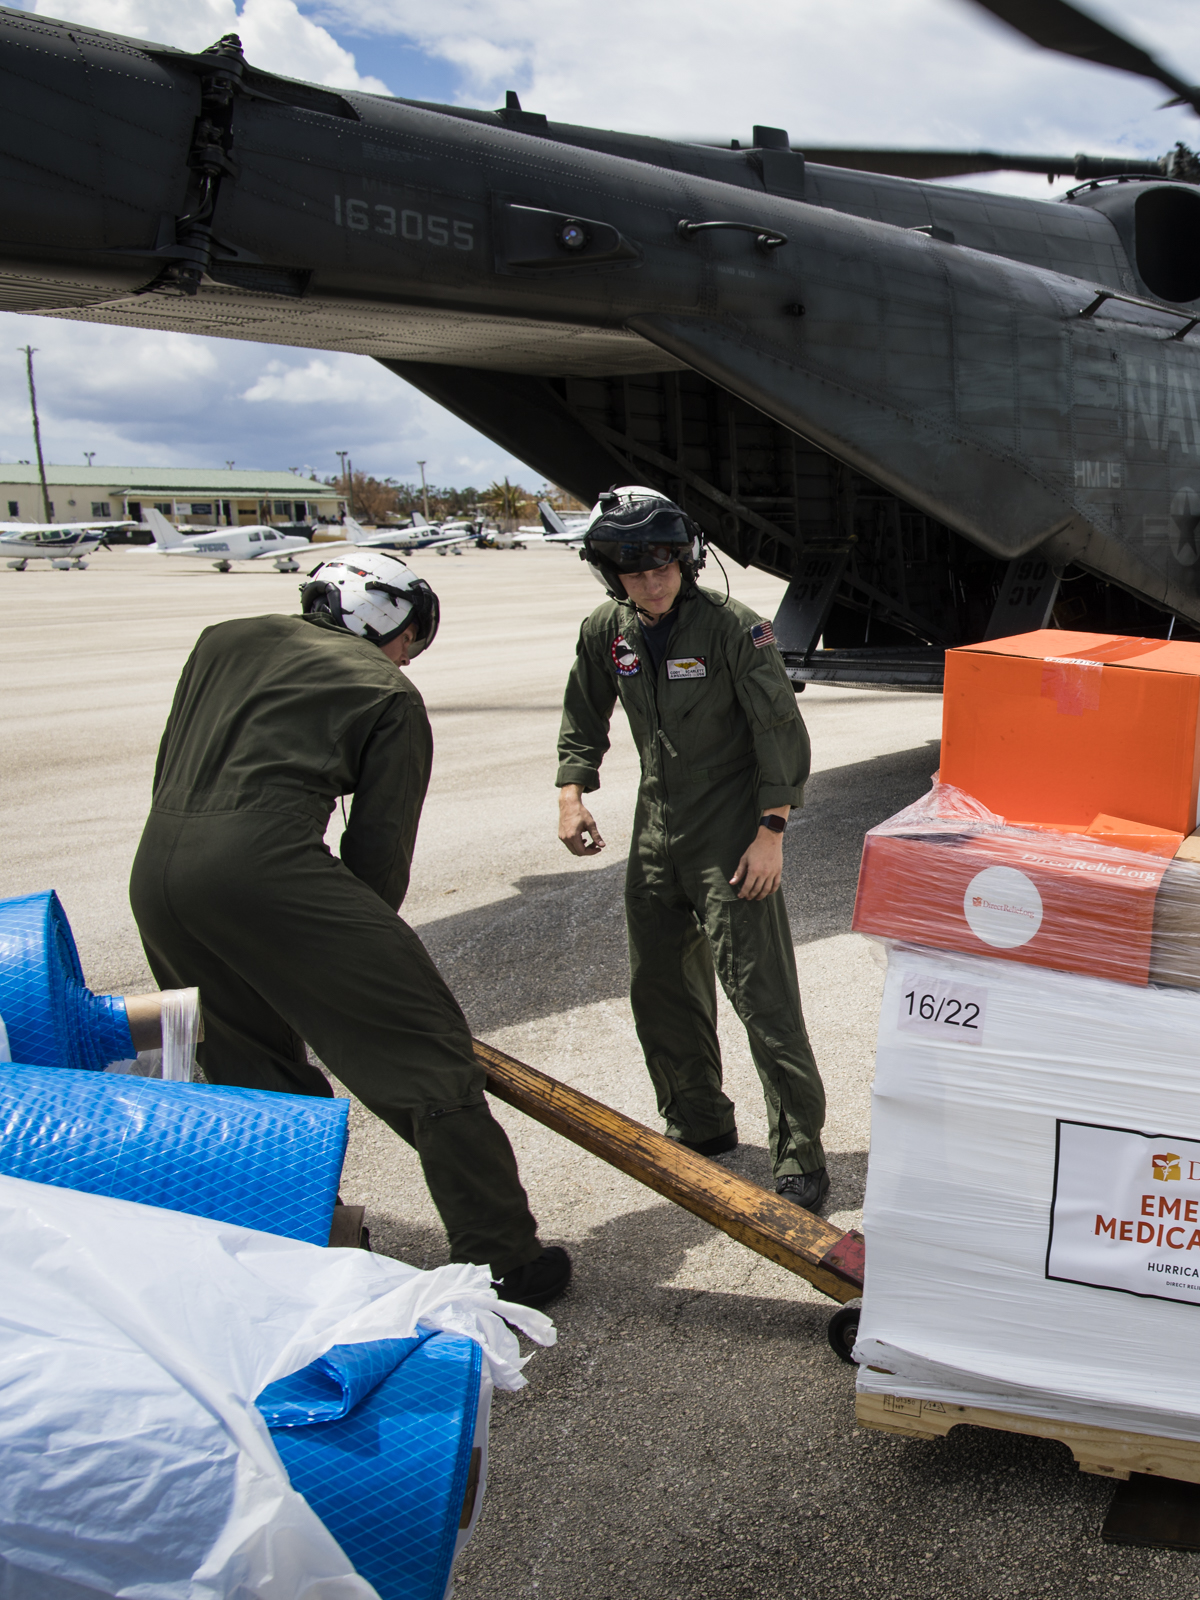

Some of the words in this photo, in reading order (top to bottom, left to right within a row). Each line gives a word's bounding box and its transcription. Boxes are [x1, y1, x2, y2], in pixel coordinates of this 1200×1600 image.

[334, 194, 474, 251] 163055
[718, 265, 735, 275] HAND
[738, 268, 756, 279] HOLD
[1074, 460, 1121, 488] HM-15
[1021, 854, 1157, 882] DirectRelief.org
[982, 900, 1035, 919] DirectRelief.org
[905, 990, 980, 1029] 16/22
[1166, 1280, 1186, 1288] DIRECT
